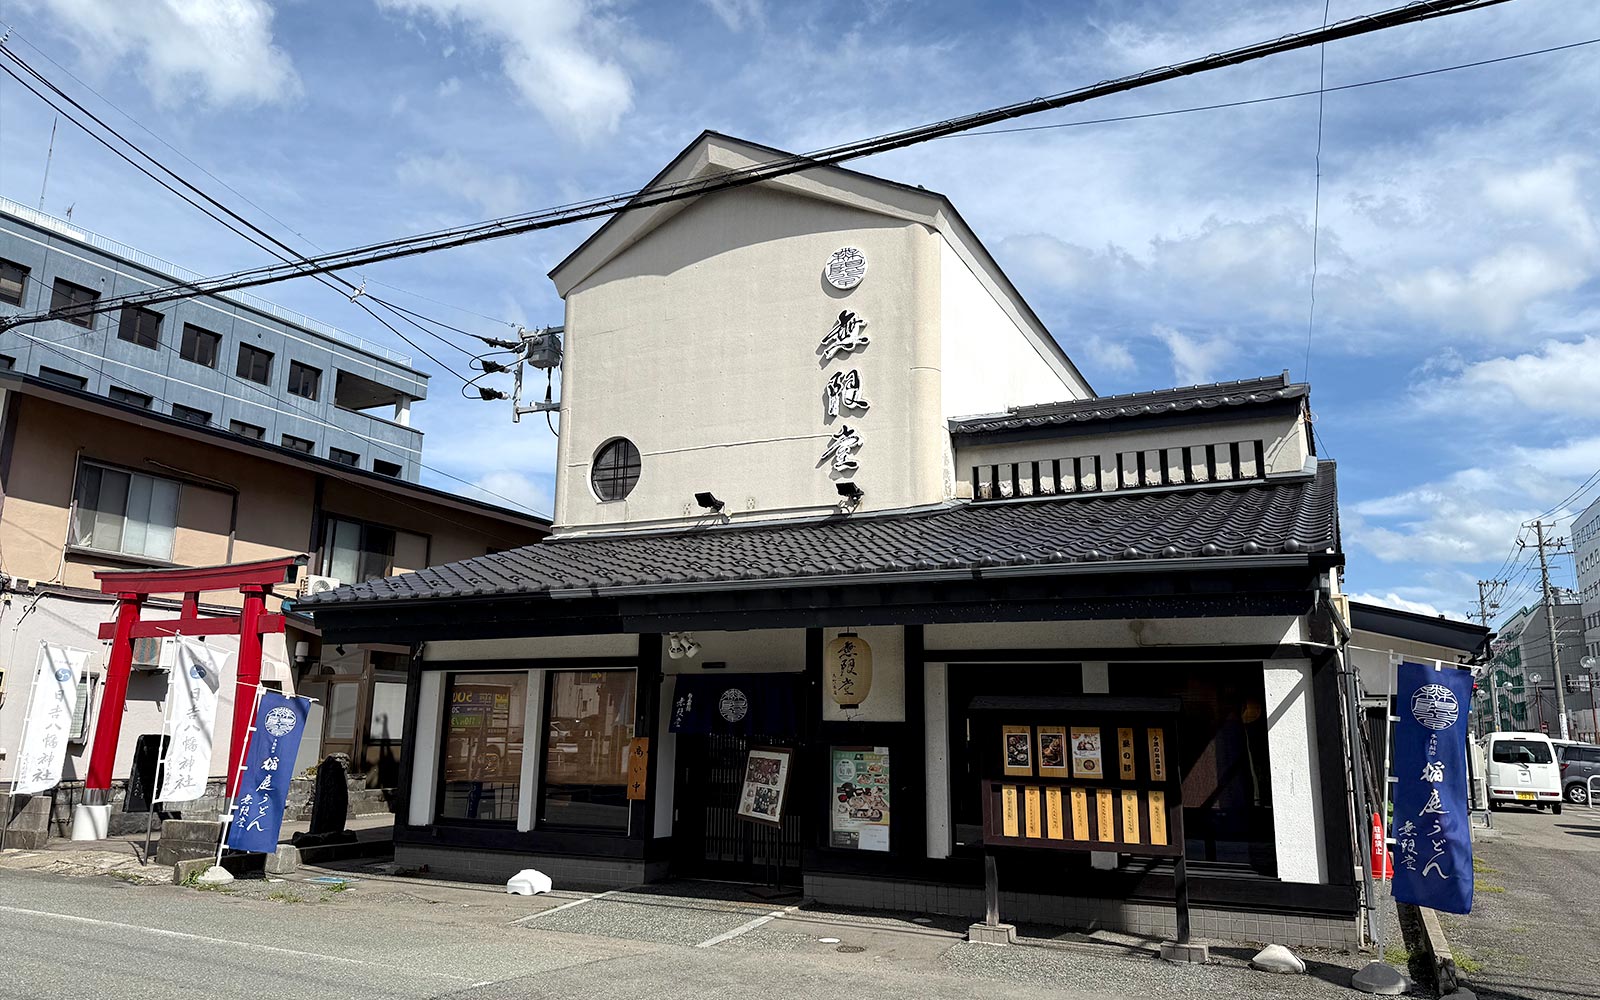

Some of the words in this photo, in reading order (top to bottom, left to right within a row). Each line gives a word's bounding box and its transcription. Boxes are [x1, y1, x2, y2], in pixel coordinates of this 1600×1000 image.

[821, 309, 870, 471] 無限堂
[838, 640, 858, 696] 無限堂
[32, 689, 65, 784] 日吉八幡神社
[174, 687, 202, 791] 日吉八幡神社
[631, 745, 645, 793] 商い中
[235, 794, 254, 828] 無限堂
[247, 756, 281, 832] 稲庭うどん
[1420, 761, 1450, 880] 稲庭うどん
[1373, 825, 1384, 855] 駐車禁止
[1398, 820, 1419, 872] 無限堂
